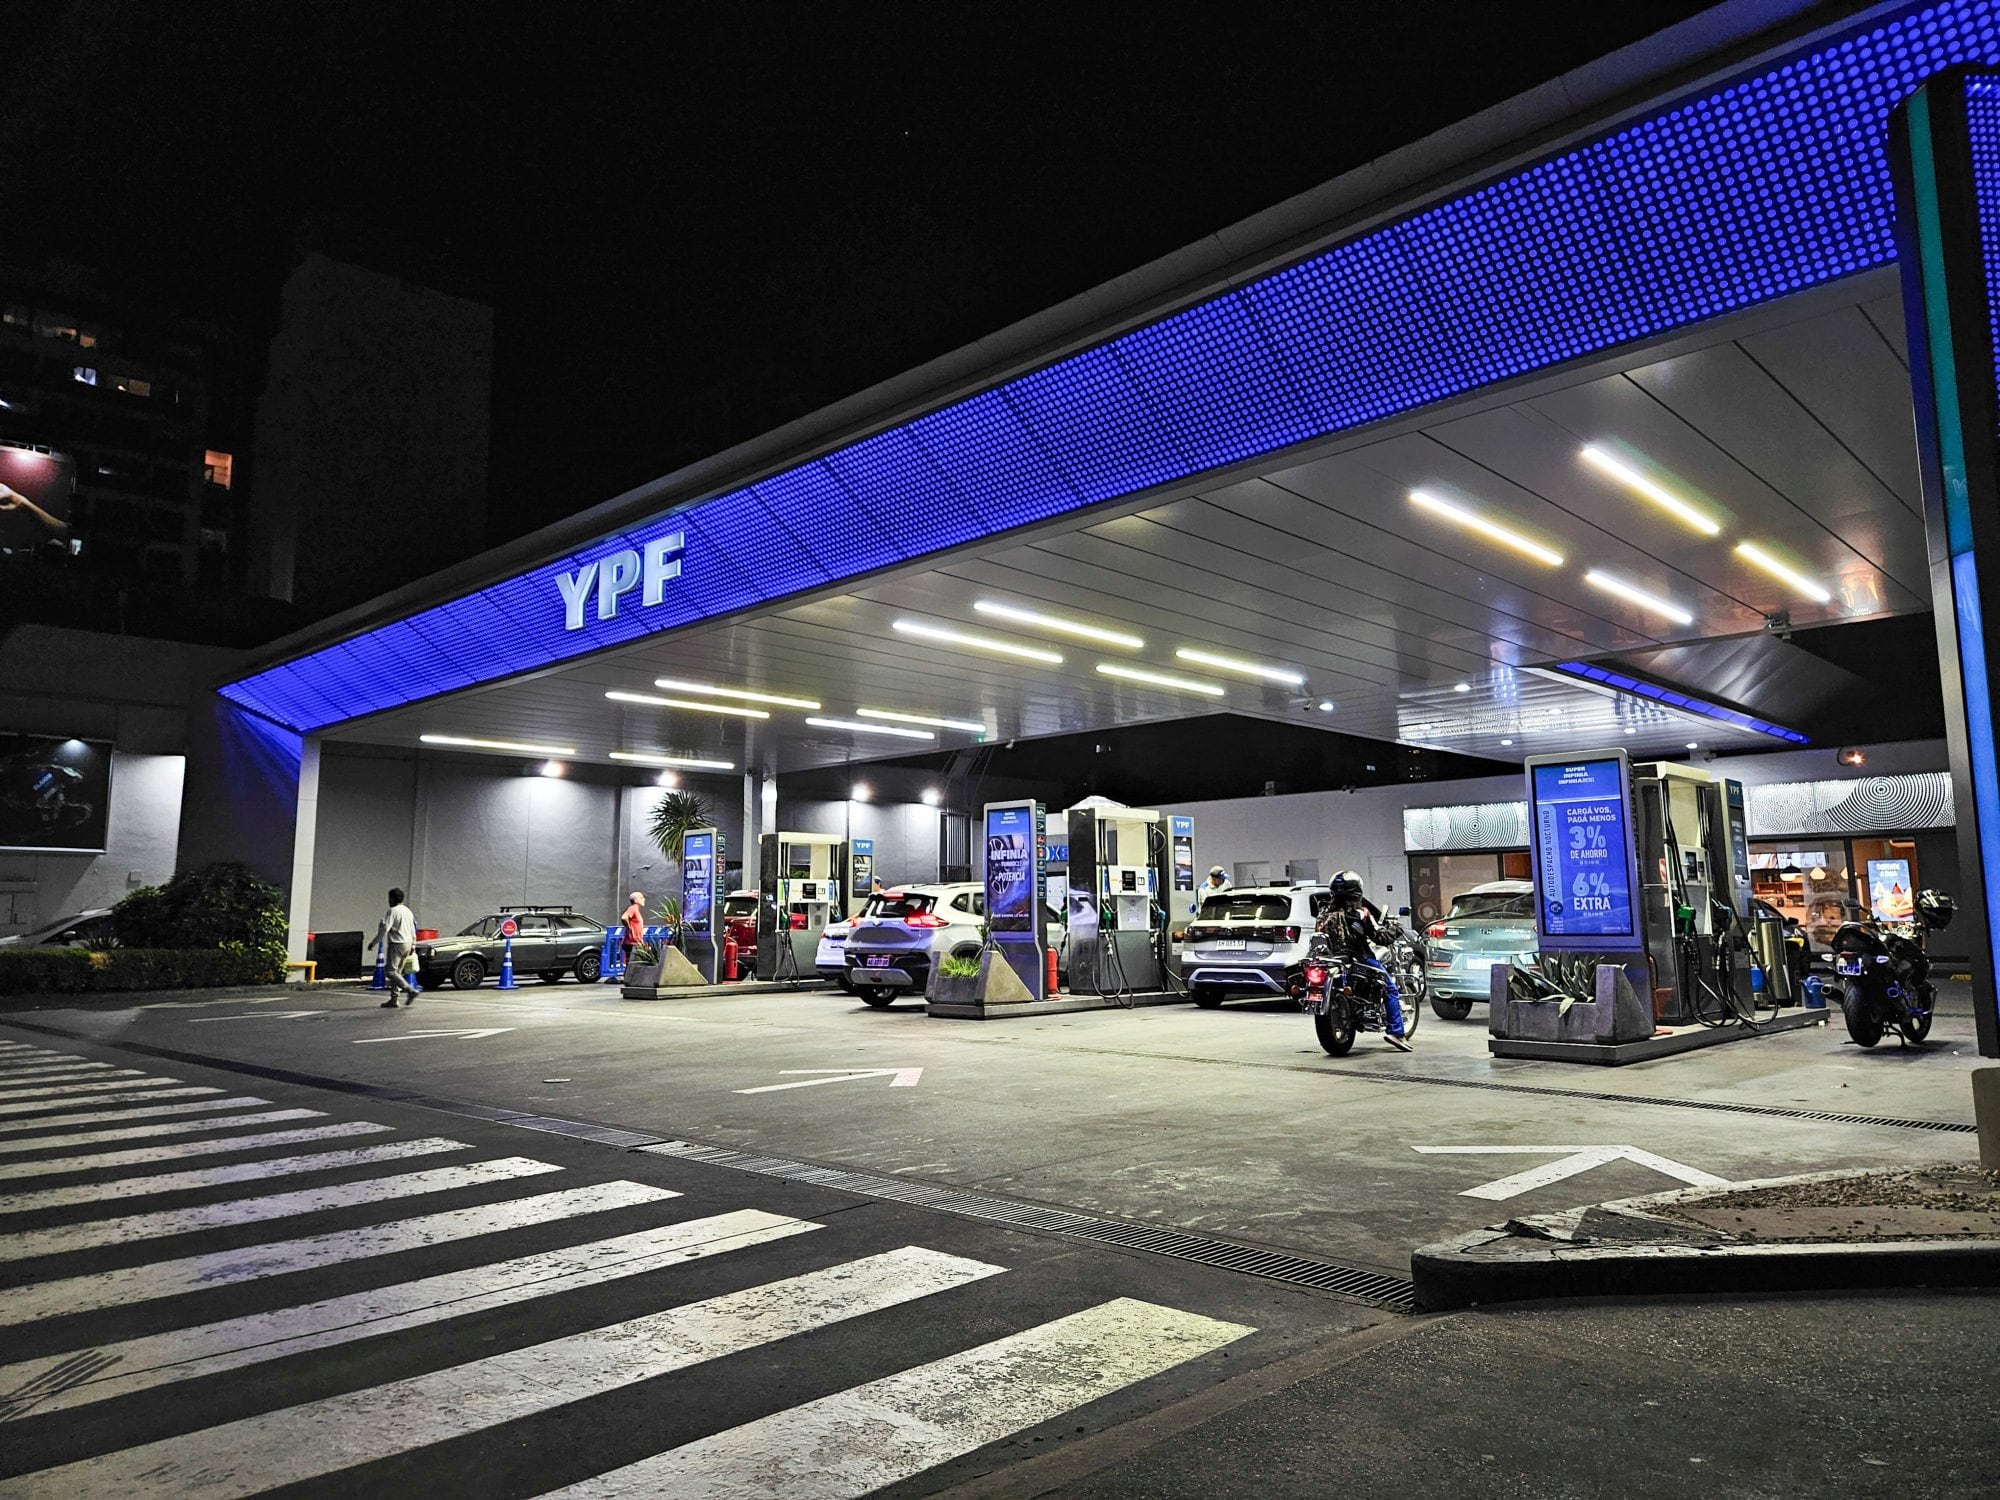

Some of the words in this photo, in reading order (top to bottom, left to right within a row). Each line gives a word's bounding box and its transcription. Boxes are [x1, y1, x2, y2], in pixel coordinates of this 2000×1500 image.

[554, 532, 685, 630] YPF
[1729, 785, 1740, 796] YPF
[1567, 806, 1592, 815] CARGÁ
[1567, 813, 1588, 823] PAGÁ
[1589, 814, 1616, 822] MENOS
[1175, 820, 1190, 829] YPF
[1542, 810, 1552, 844] NOCTURNO
[1568, 825, 1606, 850] 3%
[990, 849, 1028, 861] INFINIA
[1570, 850, 1580, 859] DE
[1581, 849, 1607, 859] AHORRO
[1545, 846, 1556, 897] AUTODESPACHO
[1572, 872, 1610, 897] 6%
